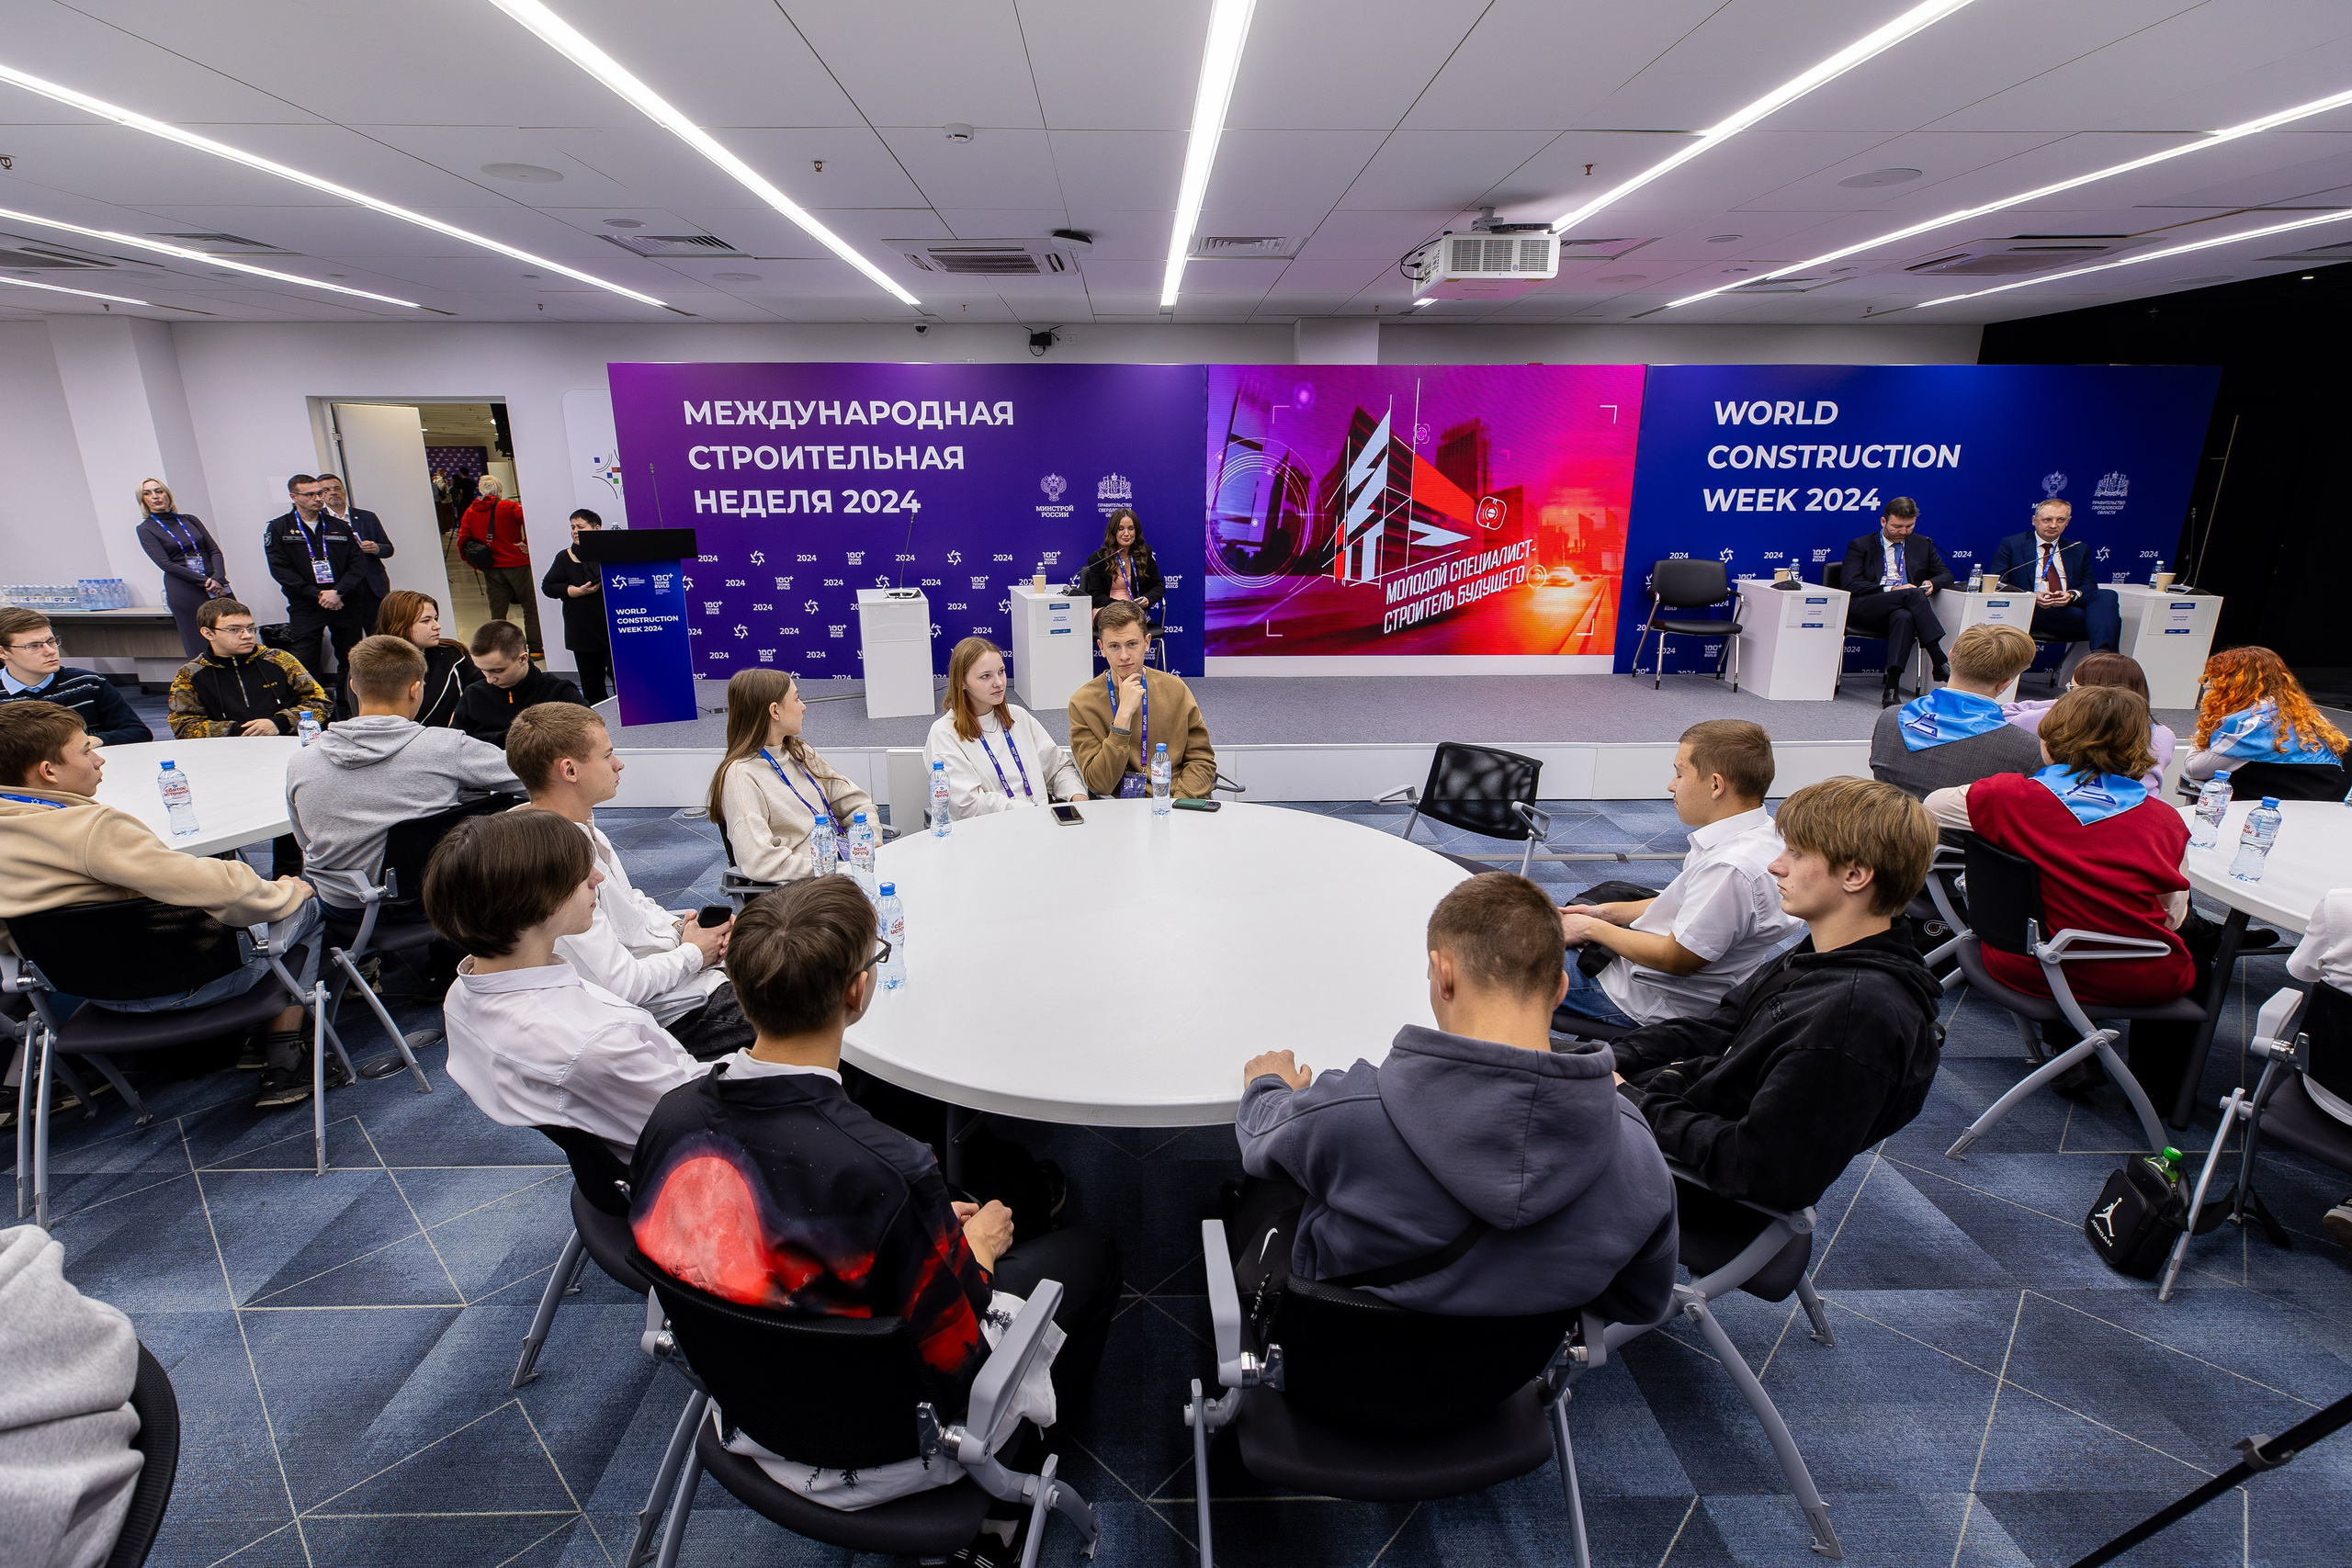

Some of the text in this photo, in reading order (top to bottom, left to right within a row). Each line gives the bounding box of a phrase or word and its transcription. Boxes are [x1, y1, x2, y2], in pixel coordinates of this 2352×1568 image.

[683, 400, 1014, 430] МЕЖДУНАРОДНАЯ
[1714, 400, 1838, 425] WORLD
[688, 446, 965, 470] СТРОИТЕЛЬНАЯ
[1707, 444, 1962, 469] CONSTRUCTION
[694, 490, 922, 518] НЕДЕЛЯ 2024
[1702, 488, 1882, 512] WEEK 2024
[725, 579, 745, 587] 2024
[1385, 538, 1537, 605] МОЛОДОЙ СПЕЦИАЛИСТ-
[1384, 565, 1526, 635] СТРОИТЕЛЬ БУДУЩЕГО
[616, 615, 679, 625] CONSTRUCTION
[2091, 1219, 2113, 1247] JORDAN
